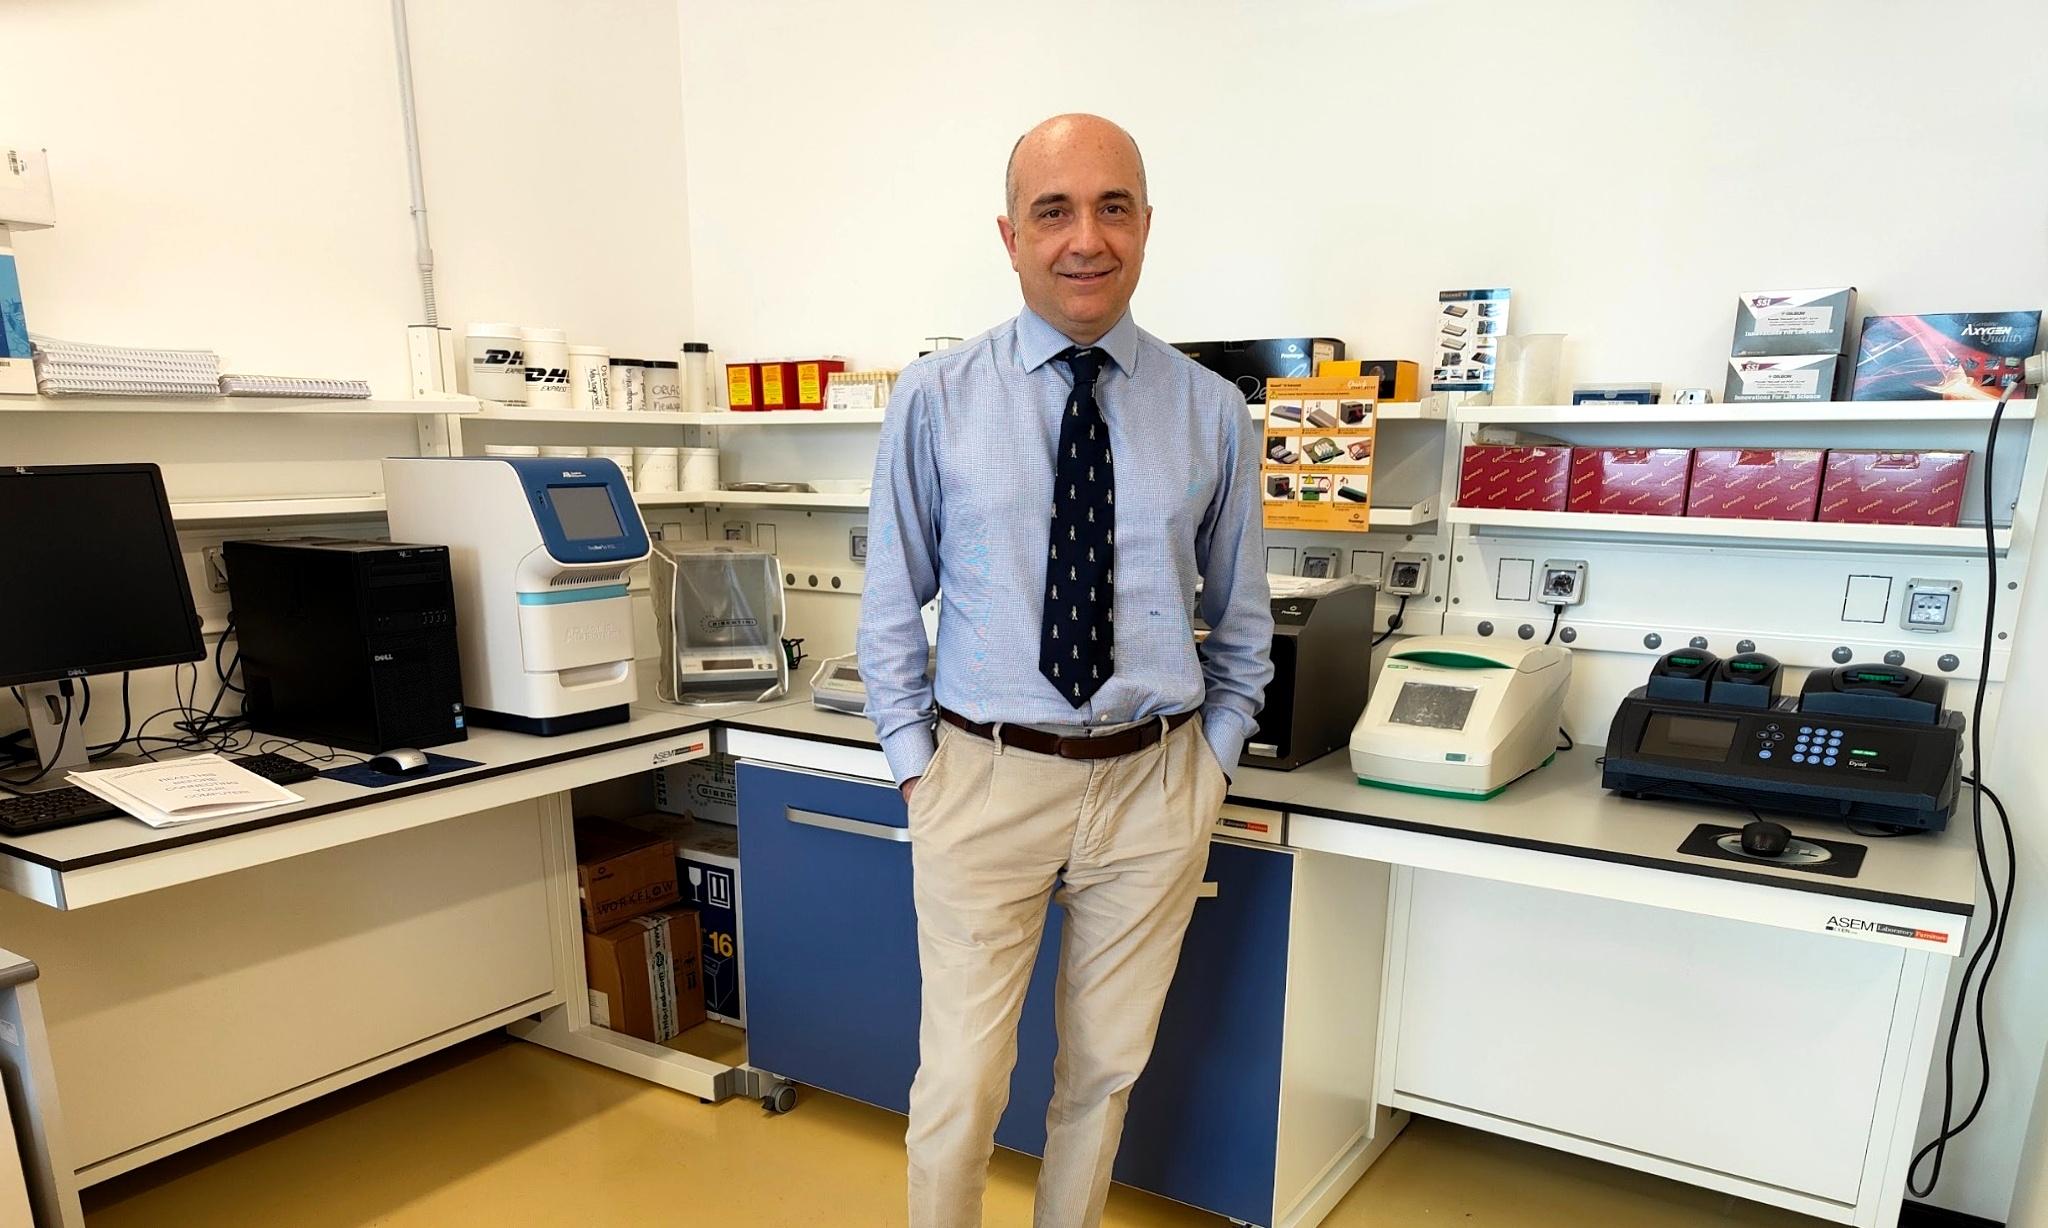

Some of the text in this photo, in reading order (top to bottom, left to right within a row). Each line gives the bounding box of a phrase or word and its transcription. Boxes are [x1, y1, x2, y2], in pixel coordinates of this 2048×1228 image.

[1756, 299, 1771, 307] SSI
[1981, 332, 2022, 345] Quality
[485, 349, 525, 365] DH
[1745, 363, 1760, 371] SSI
[1826, 915, 1875, 932] ASEM
[1877, 924, 1914, 938] Laboratory
[708, 931, 733, 958] 16
